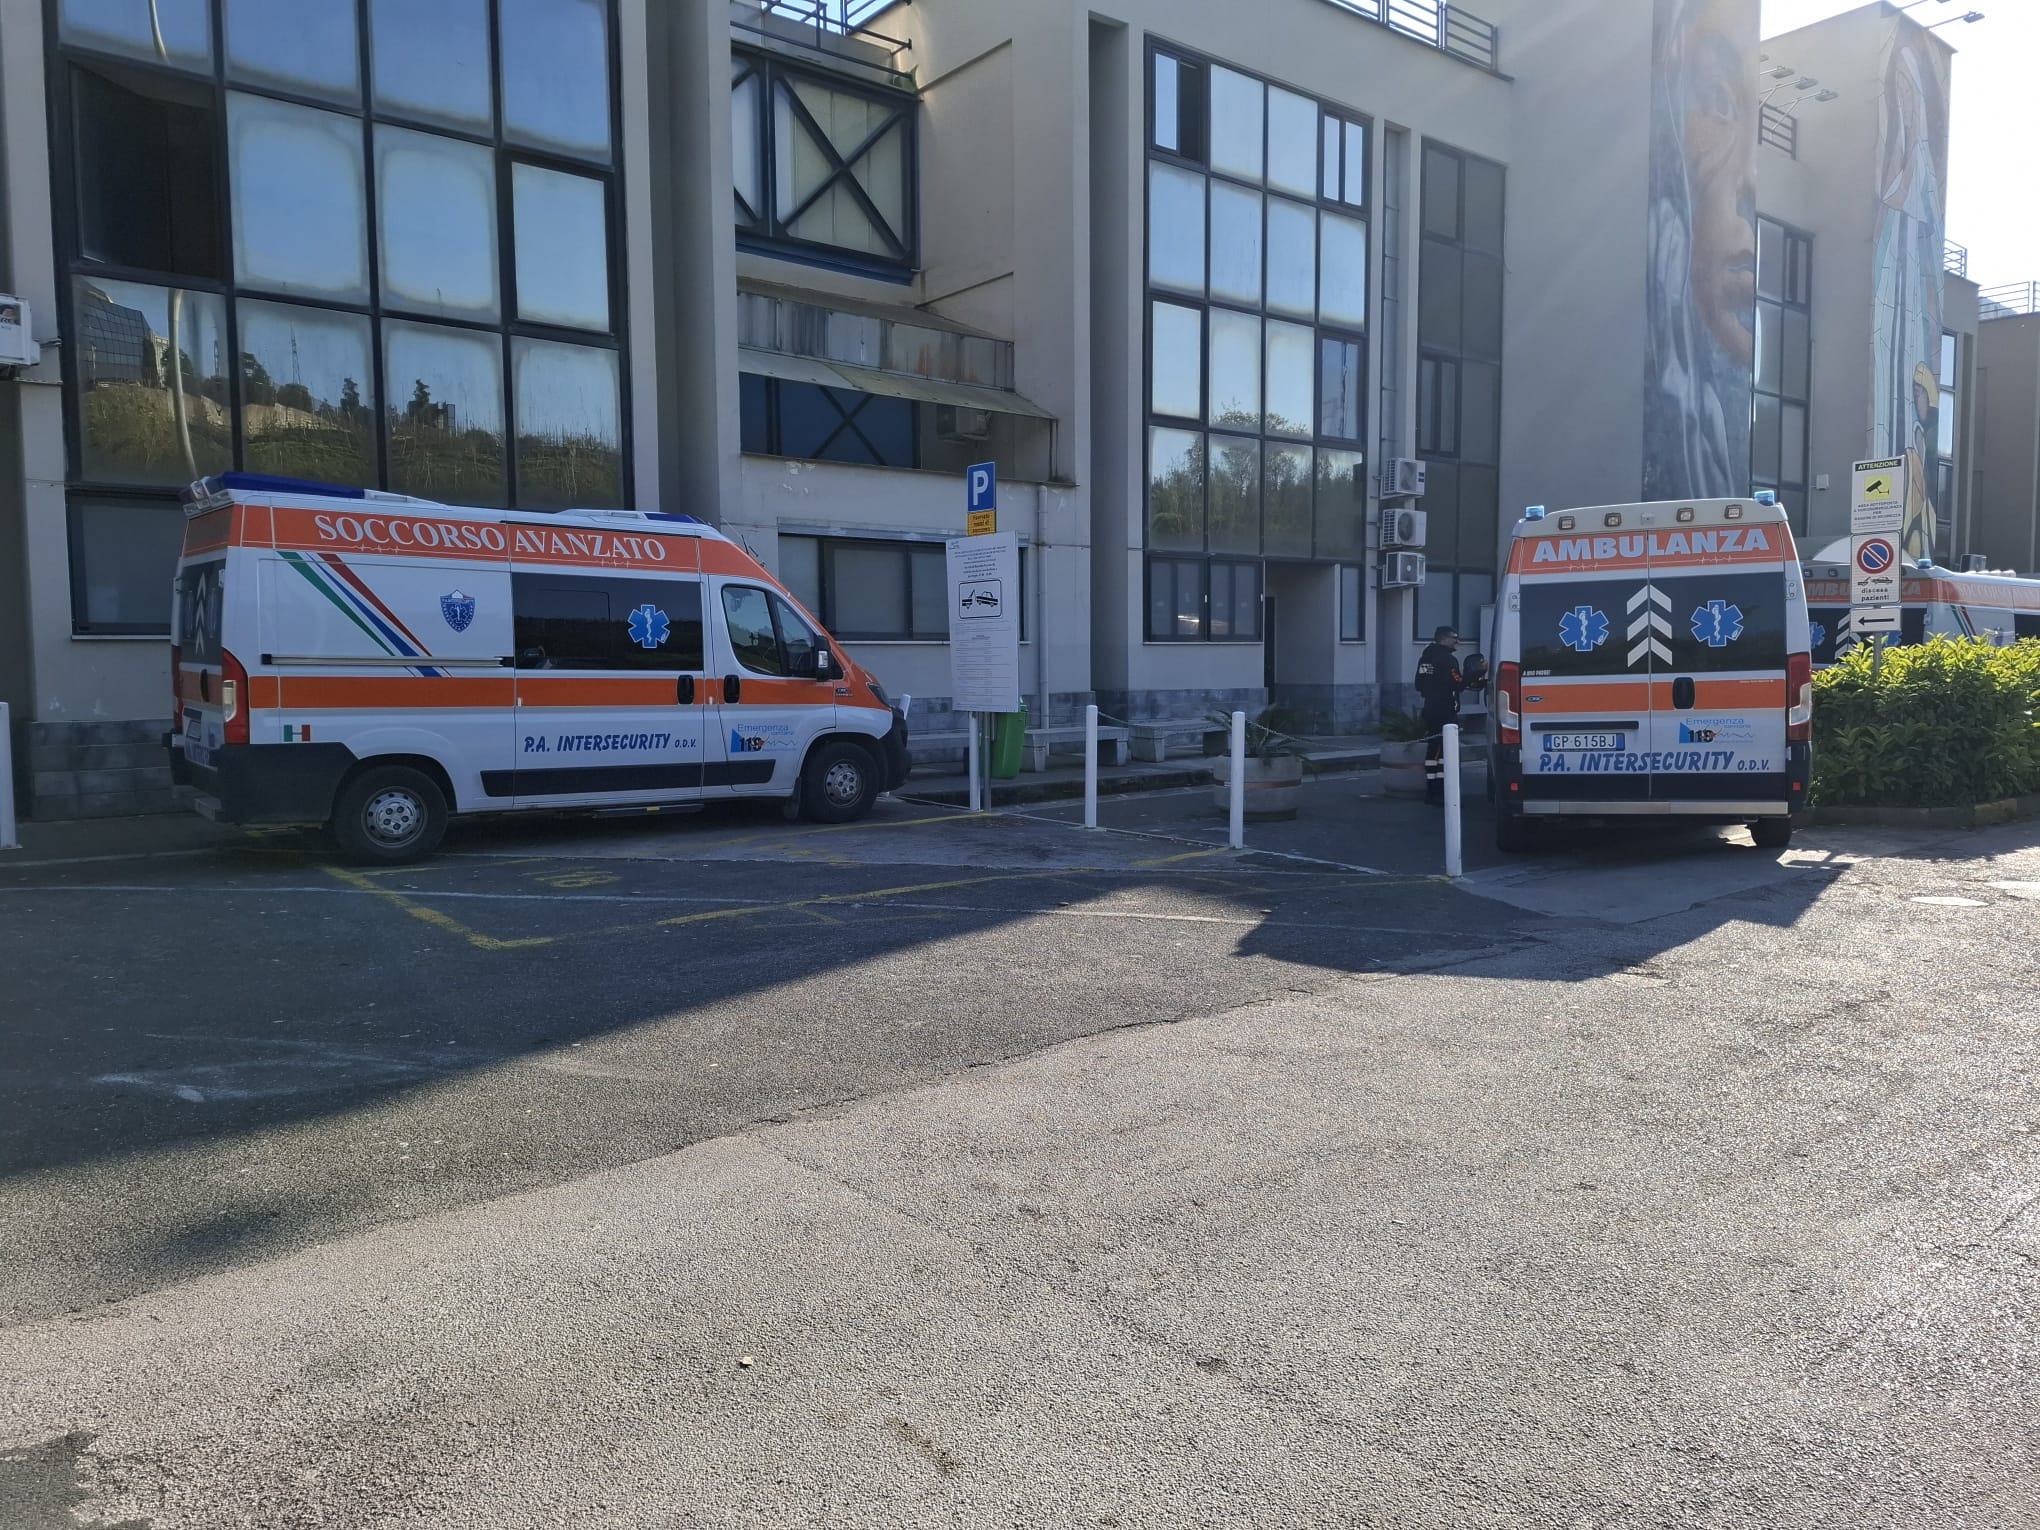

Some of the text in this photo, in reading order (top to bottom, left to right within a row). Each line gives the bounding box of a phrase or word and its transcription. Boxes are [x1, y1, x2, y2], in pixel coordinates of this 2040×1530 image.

[1858, 460, 1898, 470] ATTENZIONE
[973, 470, 989, 506] P
[315, 514, 666, 561] SOCCORSO AVANZATO
[1532, 528, 1770, 563] AMBULANZA
[1861, 594, 1889, 602] pazienti
[1686, 718, 1744, 726] Emergenza
[524, 733, 697, 752] P.A. INTERSECURITY O.D.V.
[1553, 735, 1616, 748] GP 615BJ
[1539, 750, 1770, 772] P.A. INTERSECURITY O.D.V.
